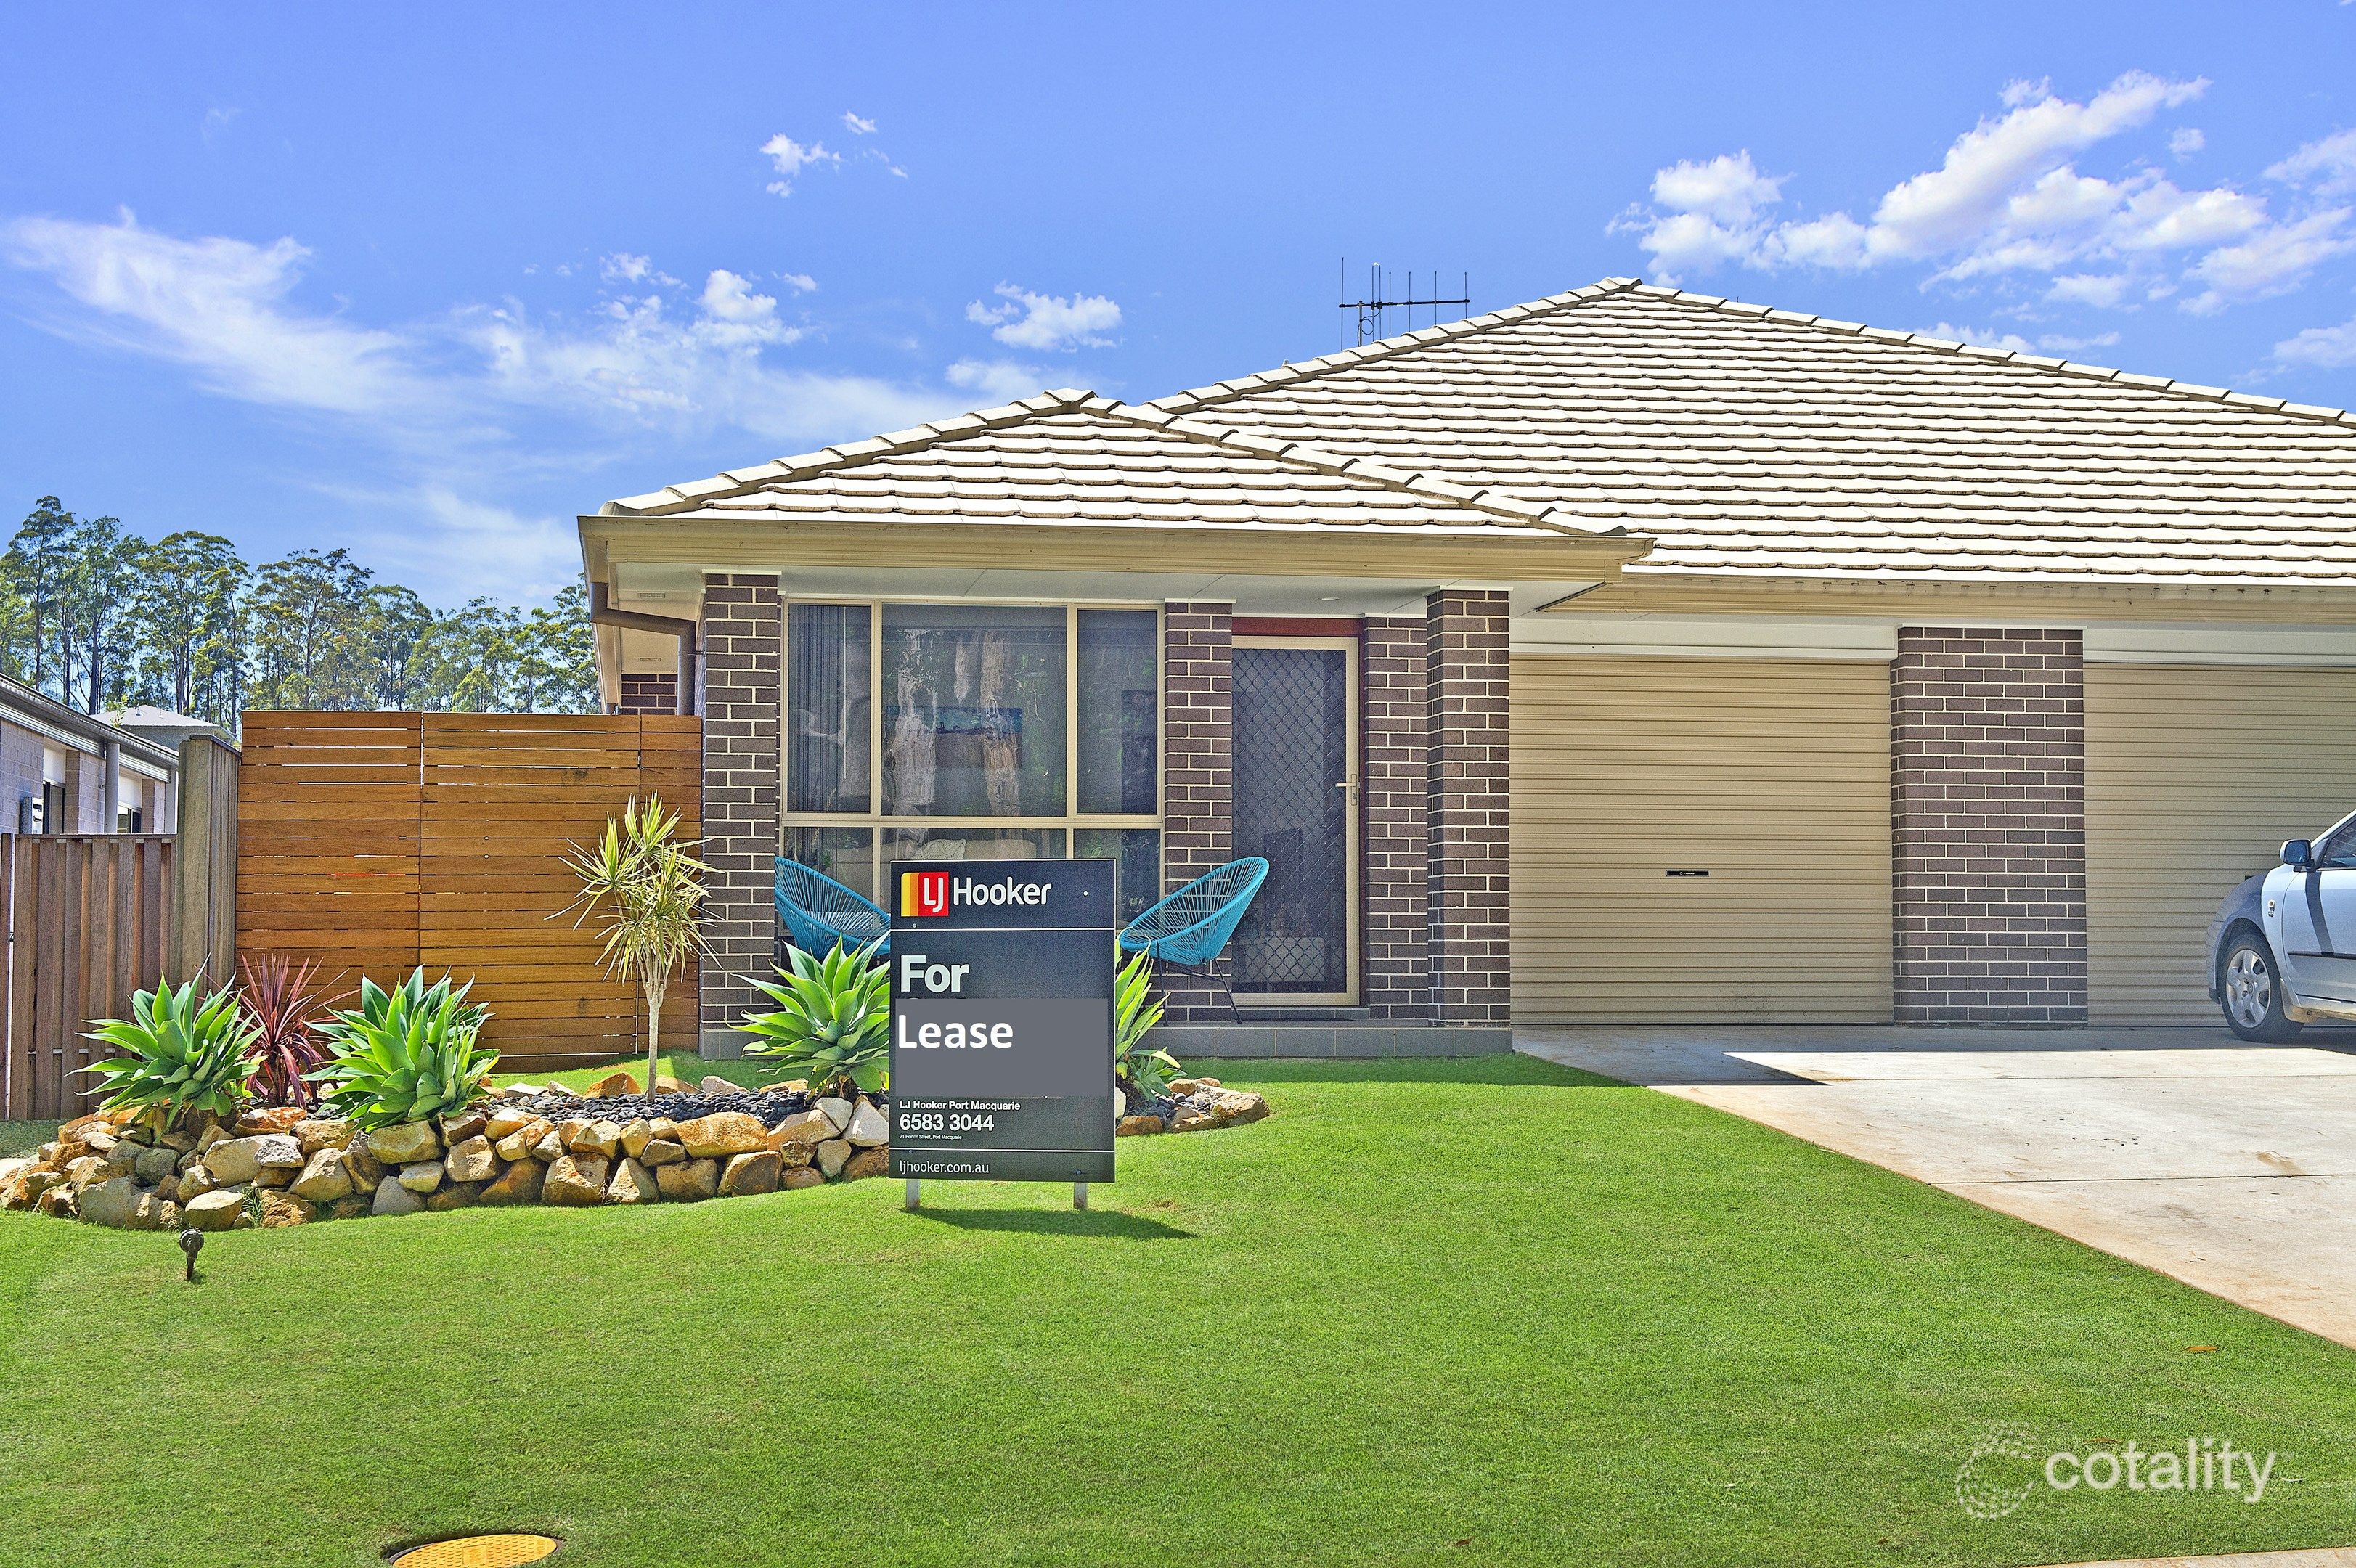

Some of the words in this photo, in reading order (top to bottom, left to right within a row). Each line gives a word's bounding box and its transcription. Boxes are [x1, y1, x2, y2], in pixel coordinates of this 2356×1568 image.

[924, 877, 944, 912] LJ
[953, 876, 1052, 905] Hooker
[900, 955, 970, 993] For
[900, 1100, 910, 1109] LJ
[913, 1100, 947, 1110] Hooker
[948, 1101, 969, 1110] Port
[971, 1101, 1021, 1112] Macquarie
[899, 1113, 944, 1131] 6583
[948, 1114, 995, 1132] 3044
[899, 1160, 990, 1175] ljhooker.com.au
